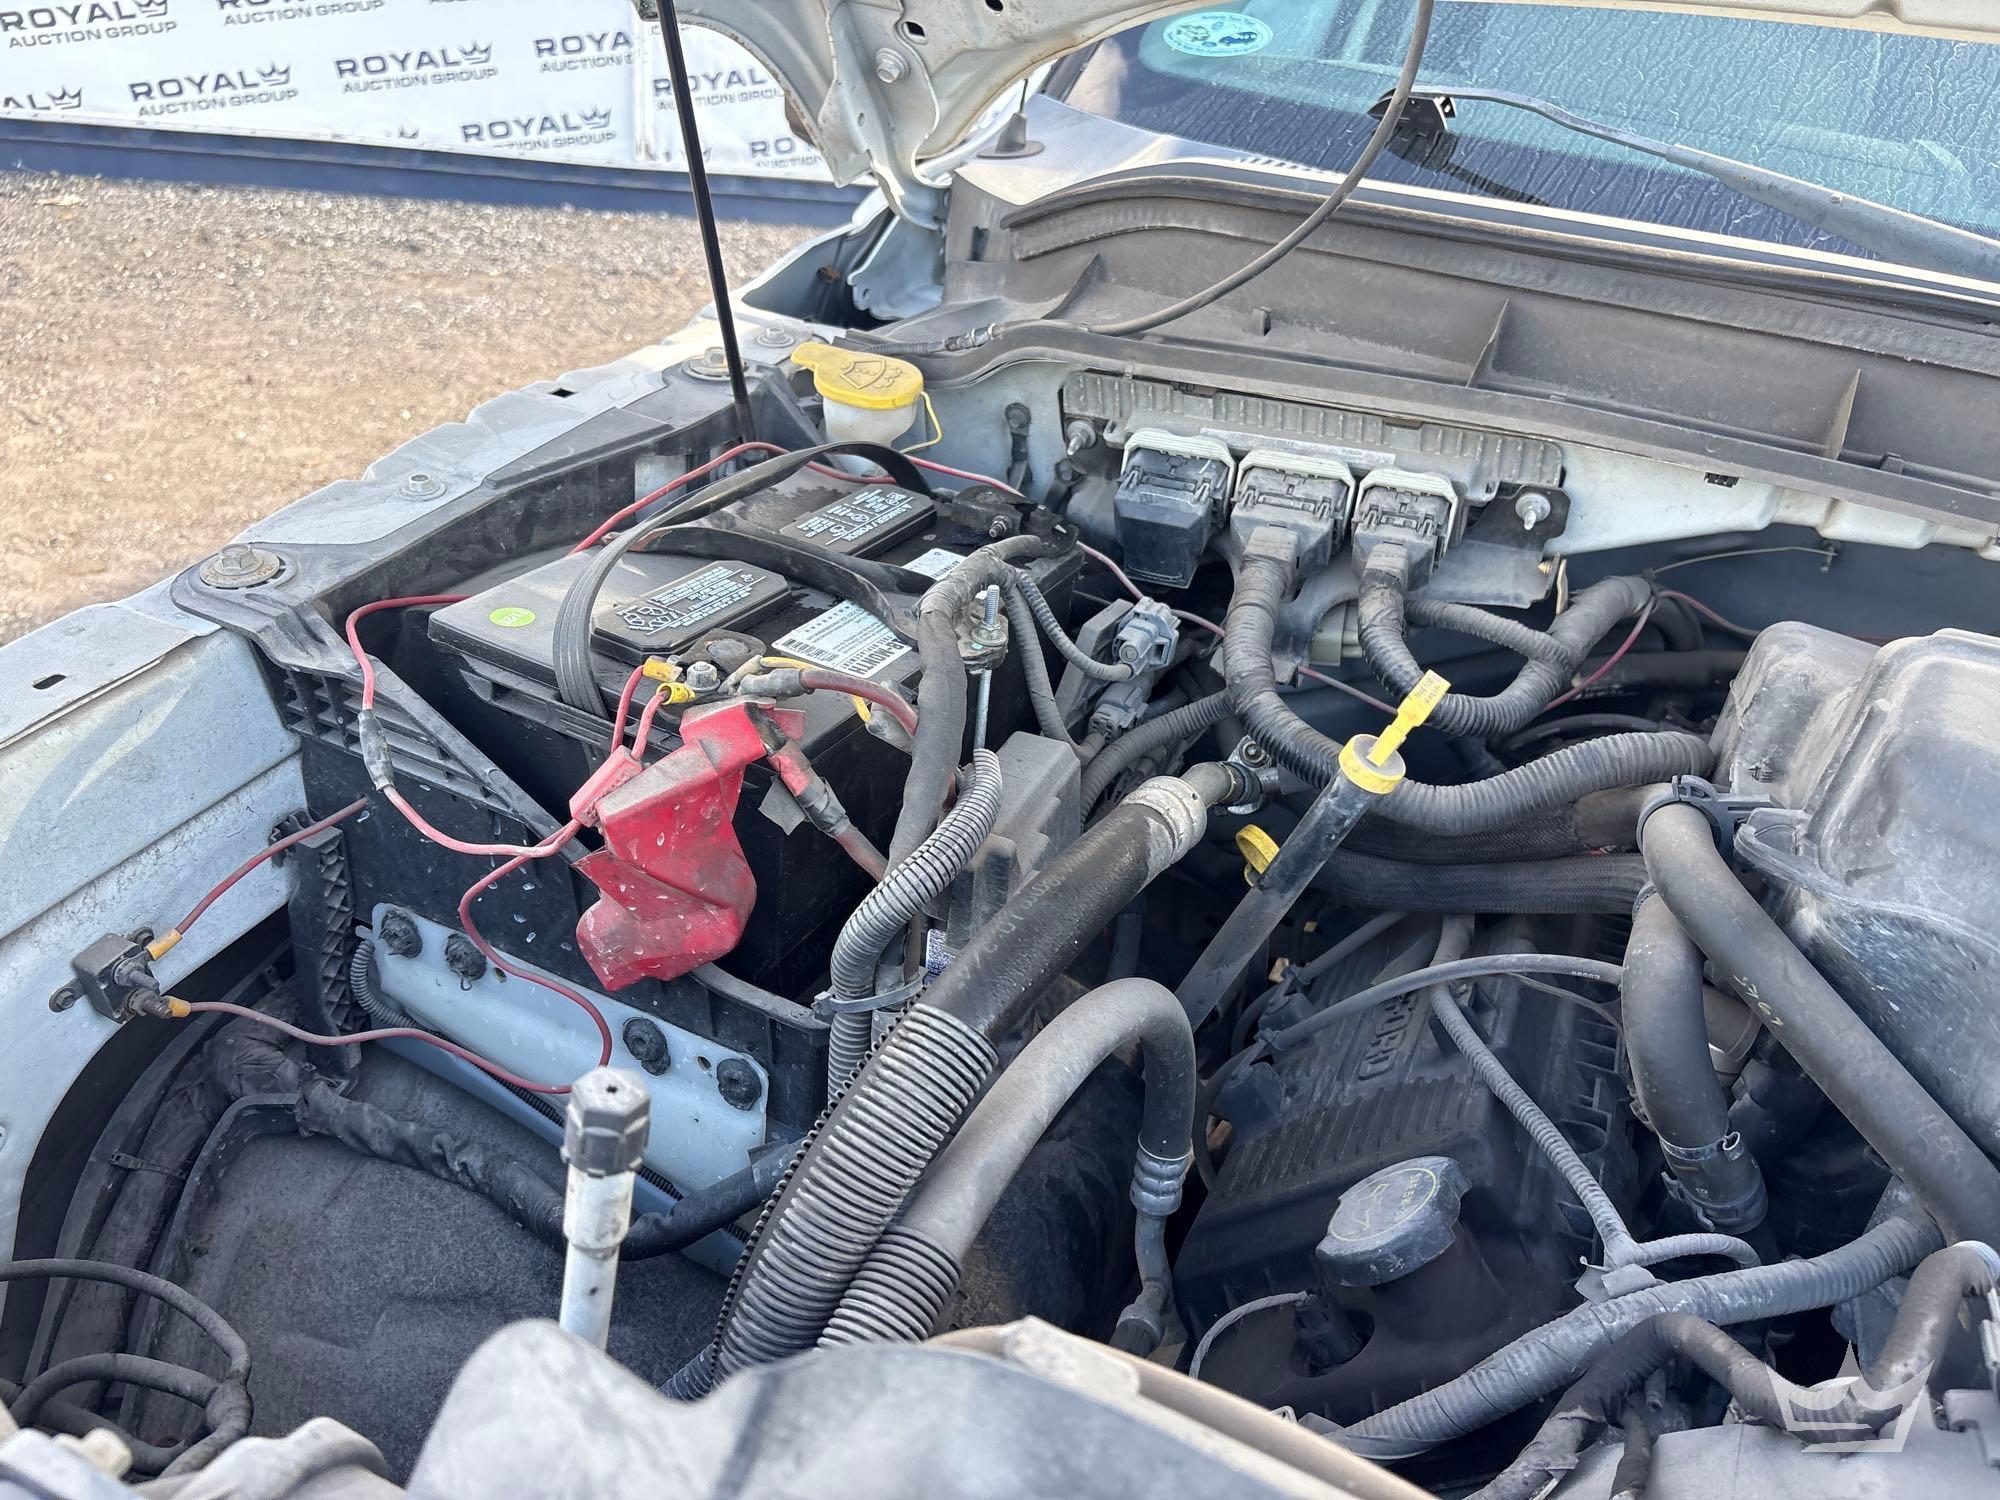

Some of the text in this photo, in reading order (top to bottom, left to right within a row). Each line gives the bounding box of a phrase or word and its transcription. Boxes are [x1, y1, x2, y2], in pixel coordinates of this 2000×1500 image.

[0, 1, 137, 31] ROYAL
[224, 6, 314, 26] AUCTION
[316, 0, 384, 16] GROUP
[9, 20, 178, 48] AUCTION GROUP
[533, 31, 633, 58] ROYA
[335, 49, 461, 78] ROYAL
[539, 55, 623, 73] AUCTION
[128, 71, 259, 101] ROYAL
[343, 67, 498, 94] AUCTION GROUP
[138, 89, 298, 117] AUCTION GROUP
[657, 86, 785, 111] AUTION GROU
[462, 114, 581, 143] ROYAL
[552, 131, 616, 148] GROUP
